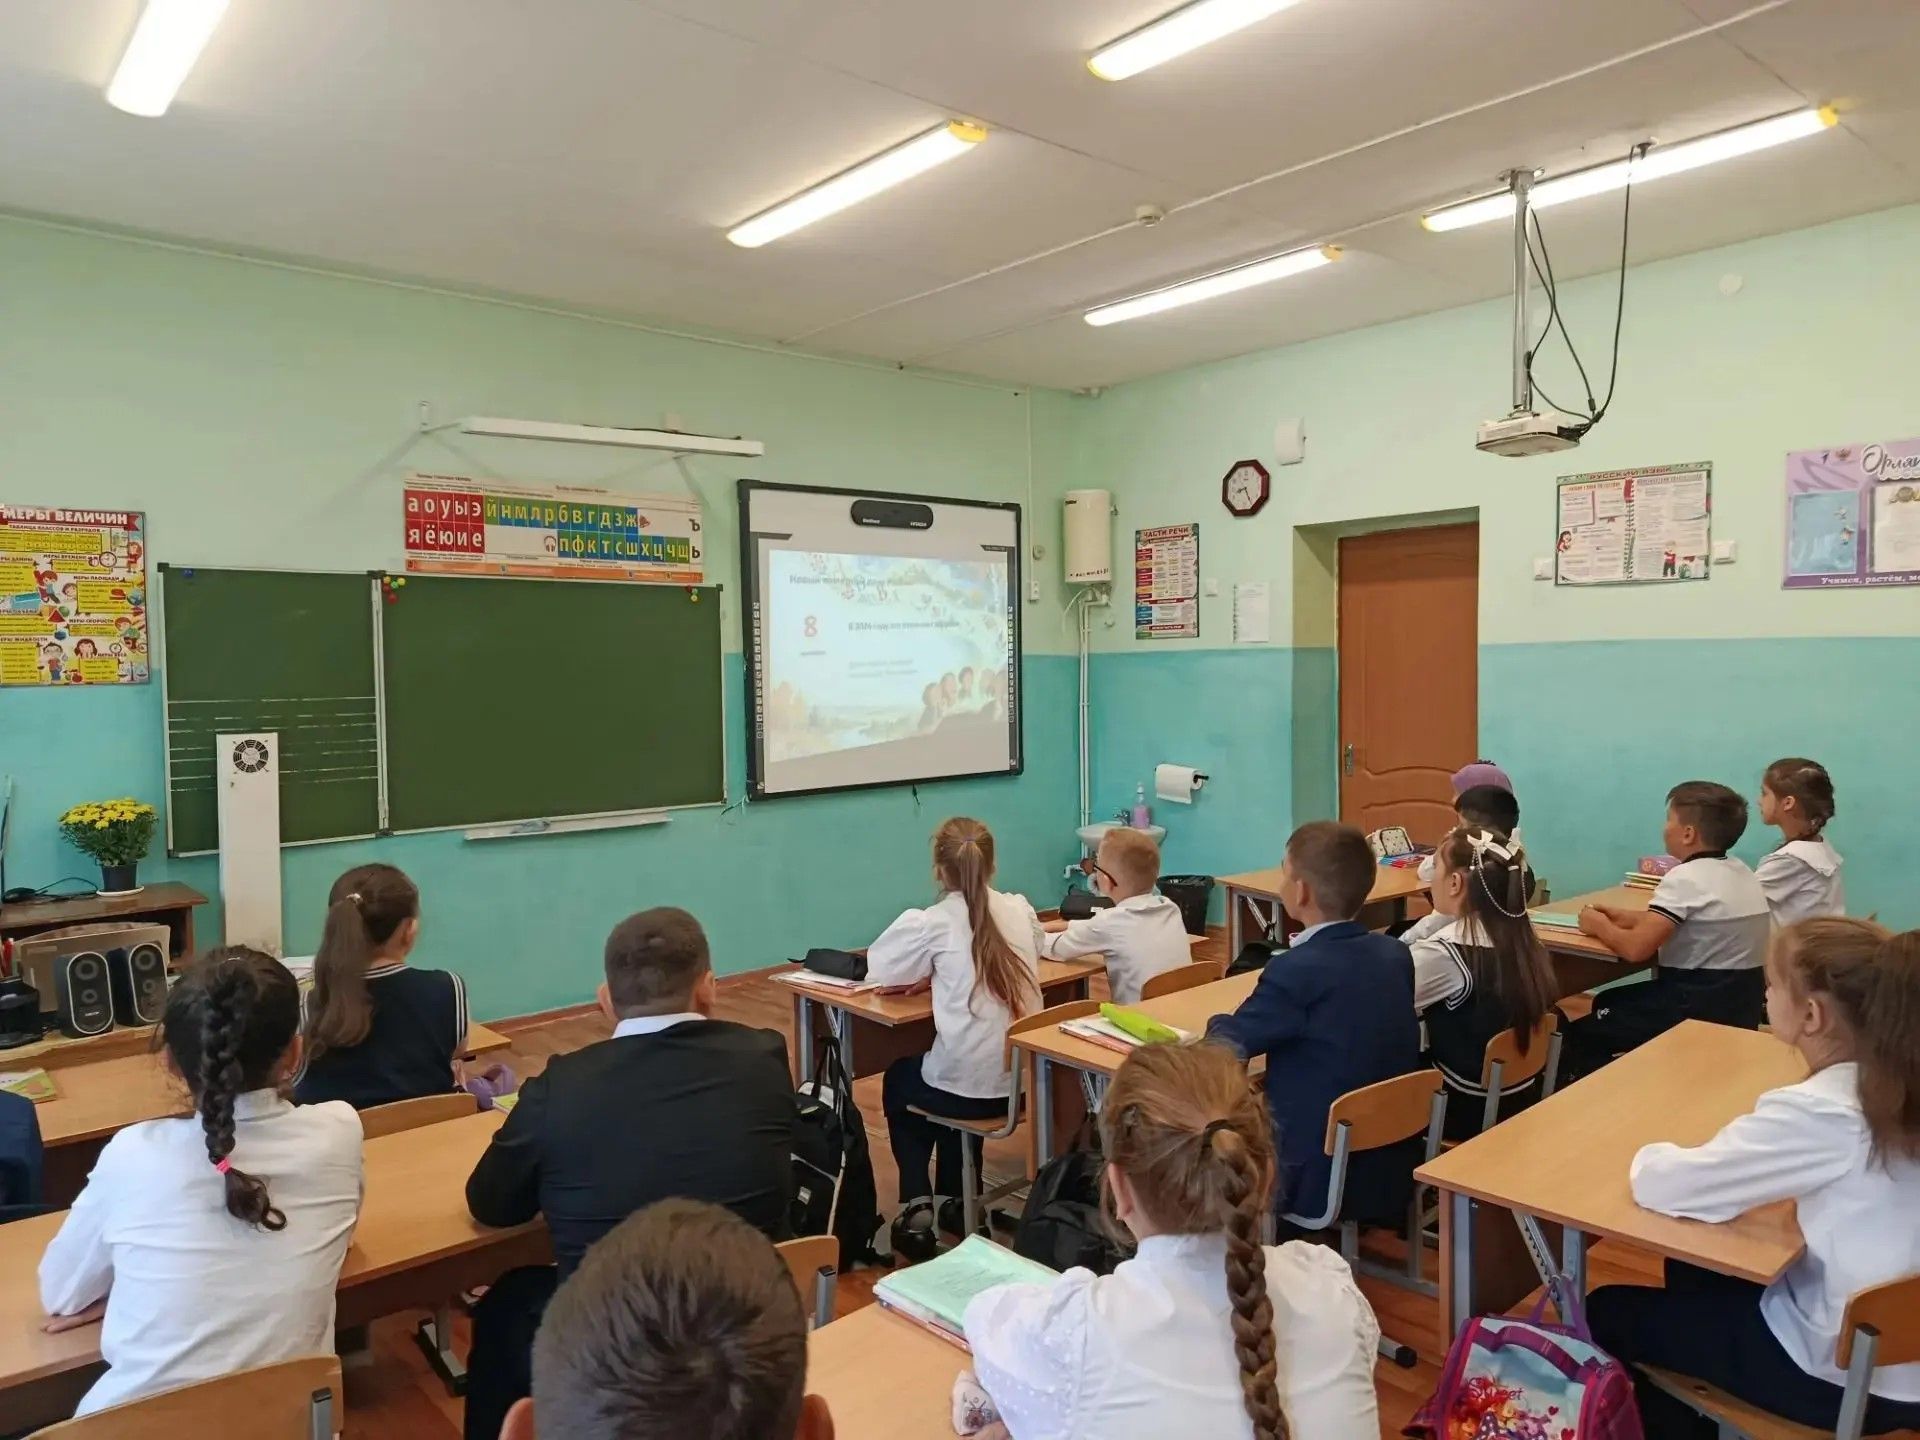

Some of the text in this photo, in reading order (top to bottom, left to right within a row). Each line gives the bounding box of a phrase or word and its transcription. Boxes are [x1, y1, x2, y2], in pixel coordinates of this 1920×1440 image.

[3, 506, 128, 525] МЕРЫ ВЕЛИЧИН
[1143, 527, 1189, 538] ЧАСТИ РЕЧИ
[804, 615, 818, 637] 8
